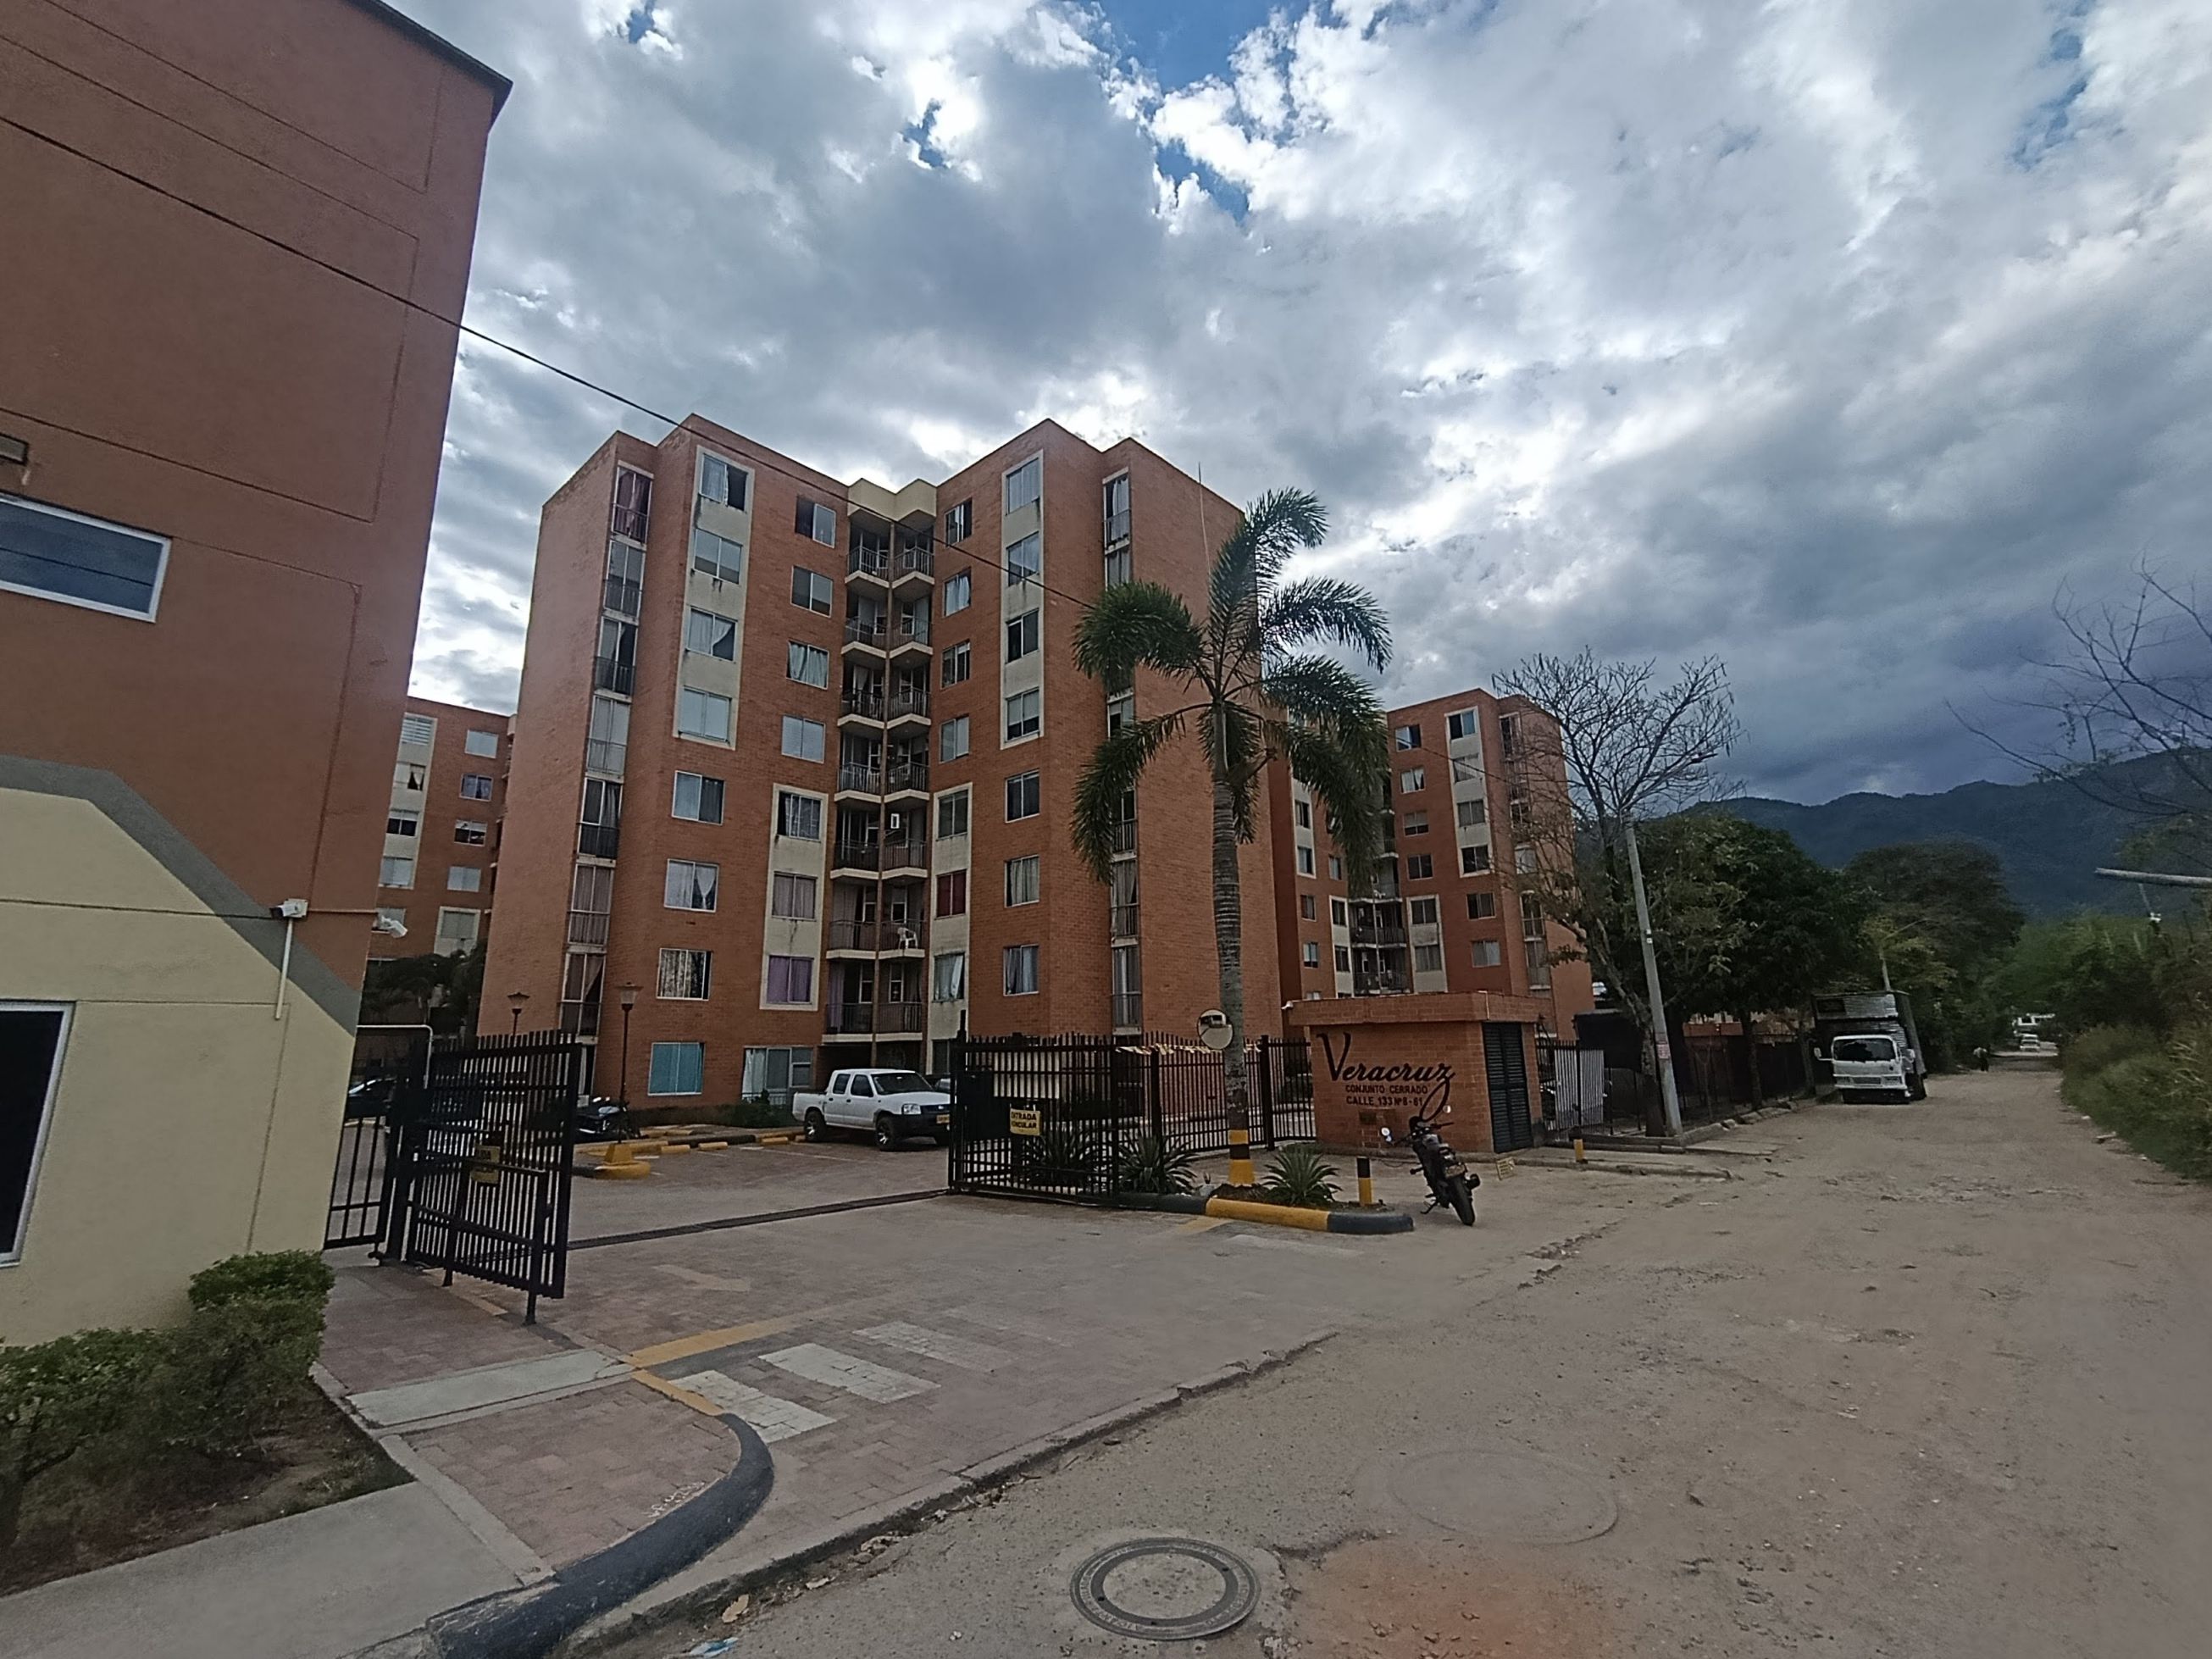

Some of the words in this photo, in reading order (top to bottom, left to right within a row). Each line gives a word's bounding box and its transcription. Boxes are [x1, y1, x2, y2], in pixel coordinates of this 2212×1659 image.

[1316, 1032, 1455, 1122] Veracruz
[1345, 1085, 1385, 1094] CONJUNTO
[1389, 1085, 1428, 1095] CERRADO
[1346, 1096, 1374, 1106] CALLE
